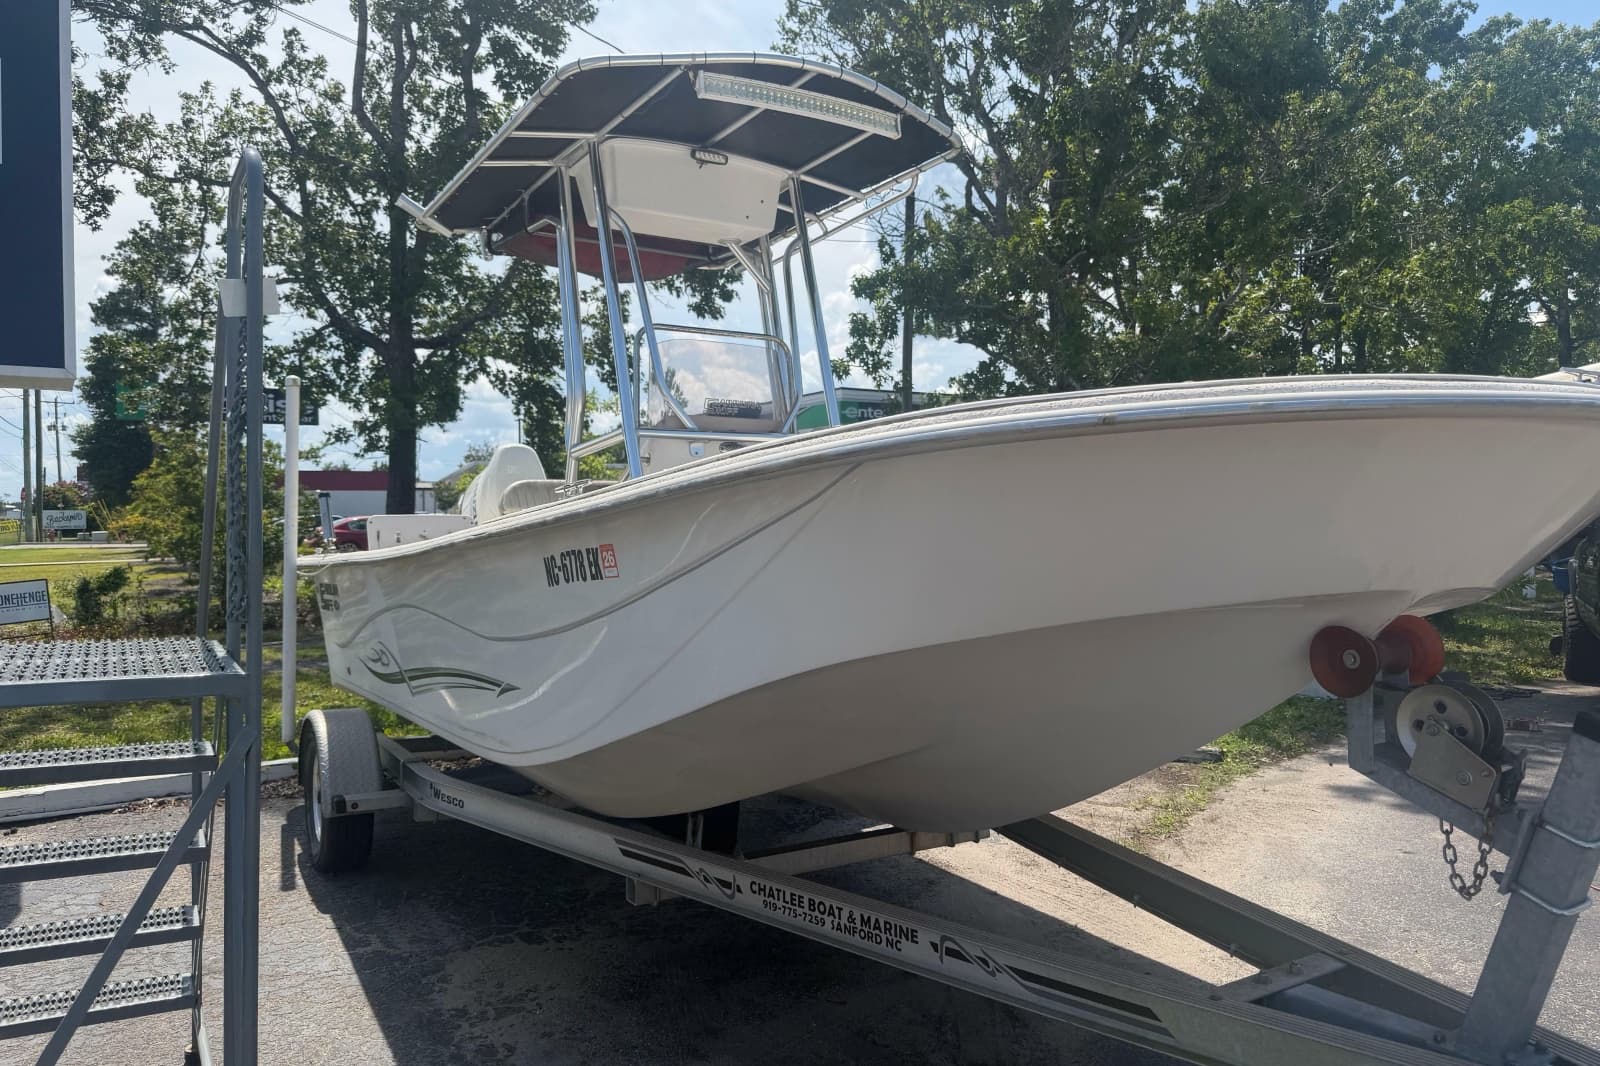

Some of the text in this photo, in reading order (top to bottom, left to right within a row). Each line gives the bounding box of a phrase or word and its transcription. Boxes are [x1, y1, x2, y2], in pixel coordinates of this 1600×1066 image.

[543, 546, 604, 588] NC-6778 EK
[602, 551, 616, 567] 26
[749, 880, 919, 945] CHATLEE BOAT & MARINE
[762, 899, 902, 952] 919-775-7259 SANFORD NC
